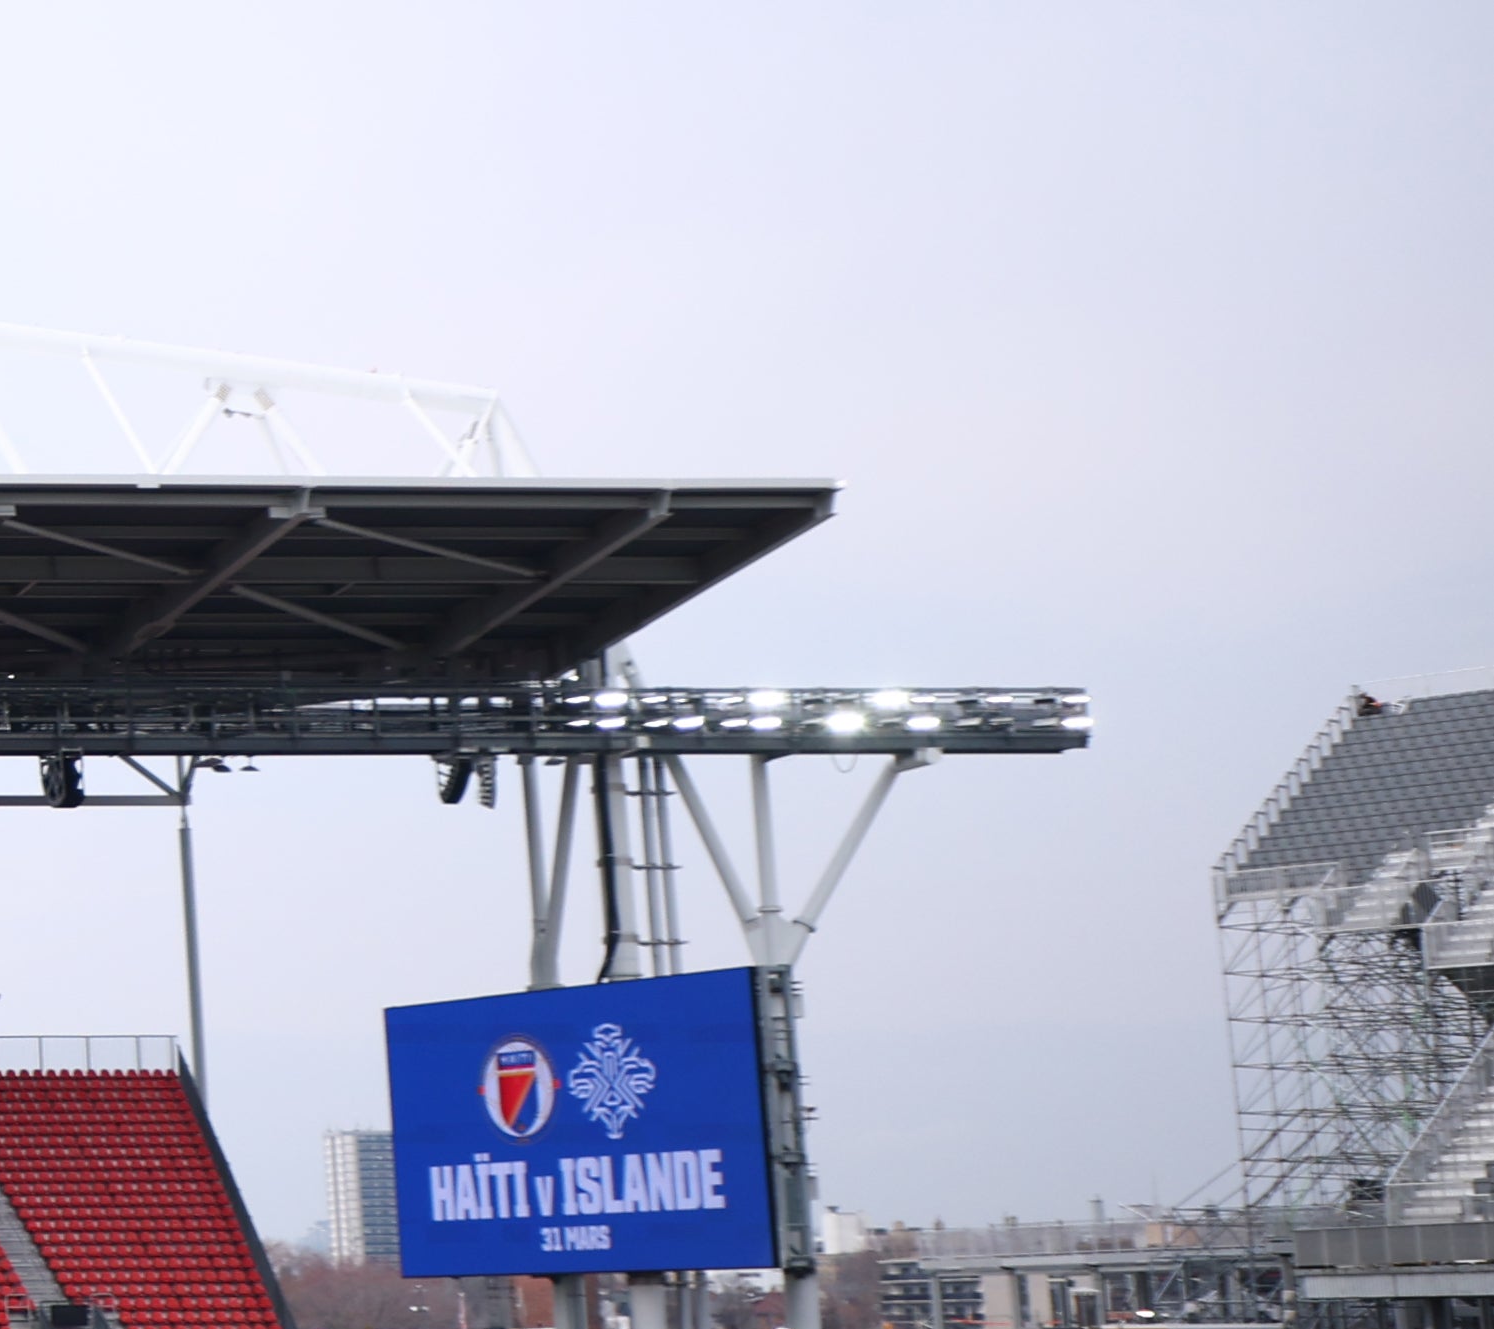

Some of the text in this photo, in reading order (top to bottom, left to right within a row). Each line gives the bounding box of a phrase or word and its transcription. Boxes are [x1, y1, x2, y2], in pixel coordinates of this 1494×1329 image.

[429, 1153, 529, 1221] HAÏTI
[558, 1149, 726, 1217] ISLANDE
[541, 1225, 610, 1252] 31 MARS
